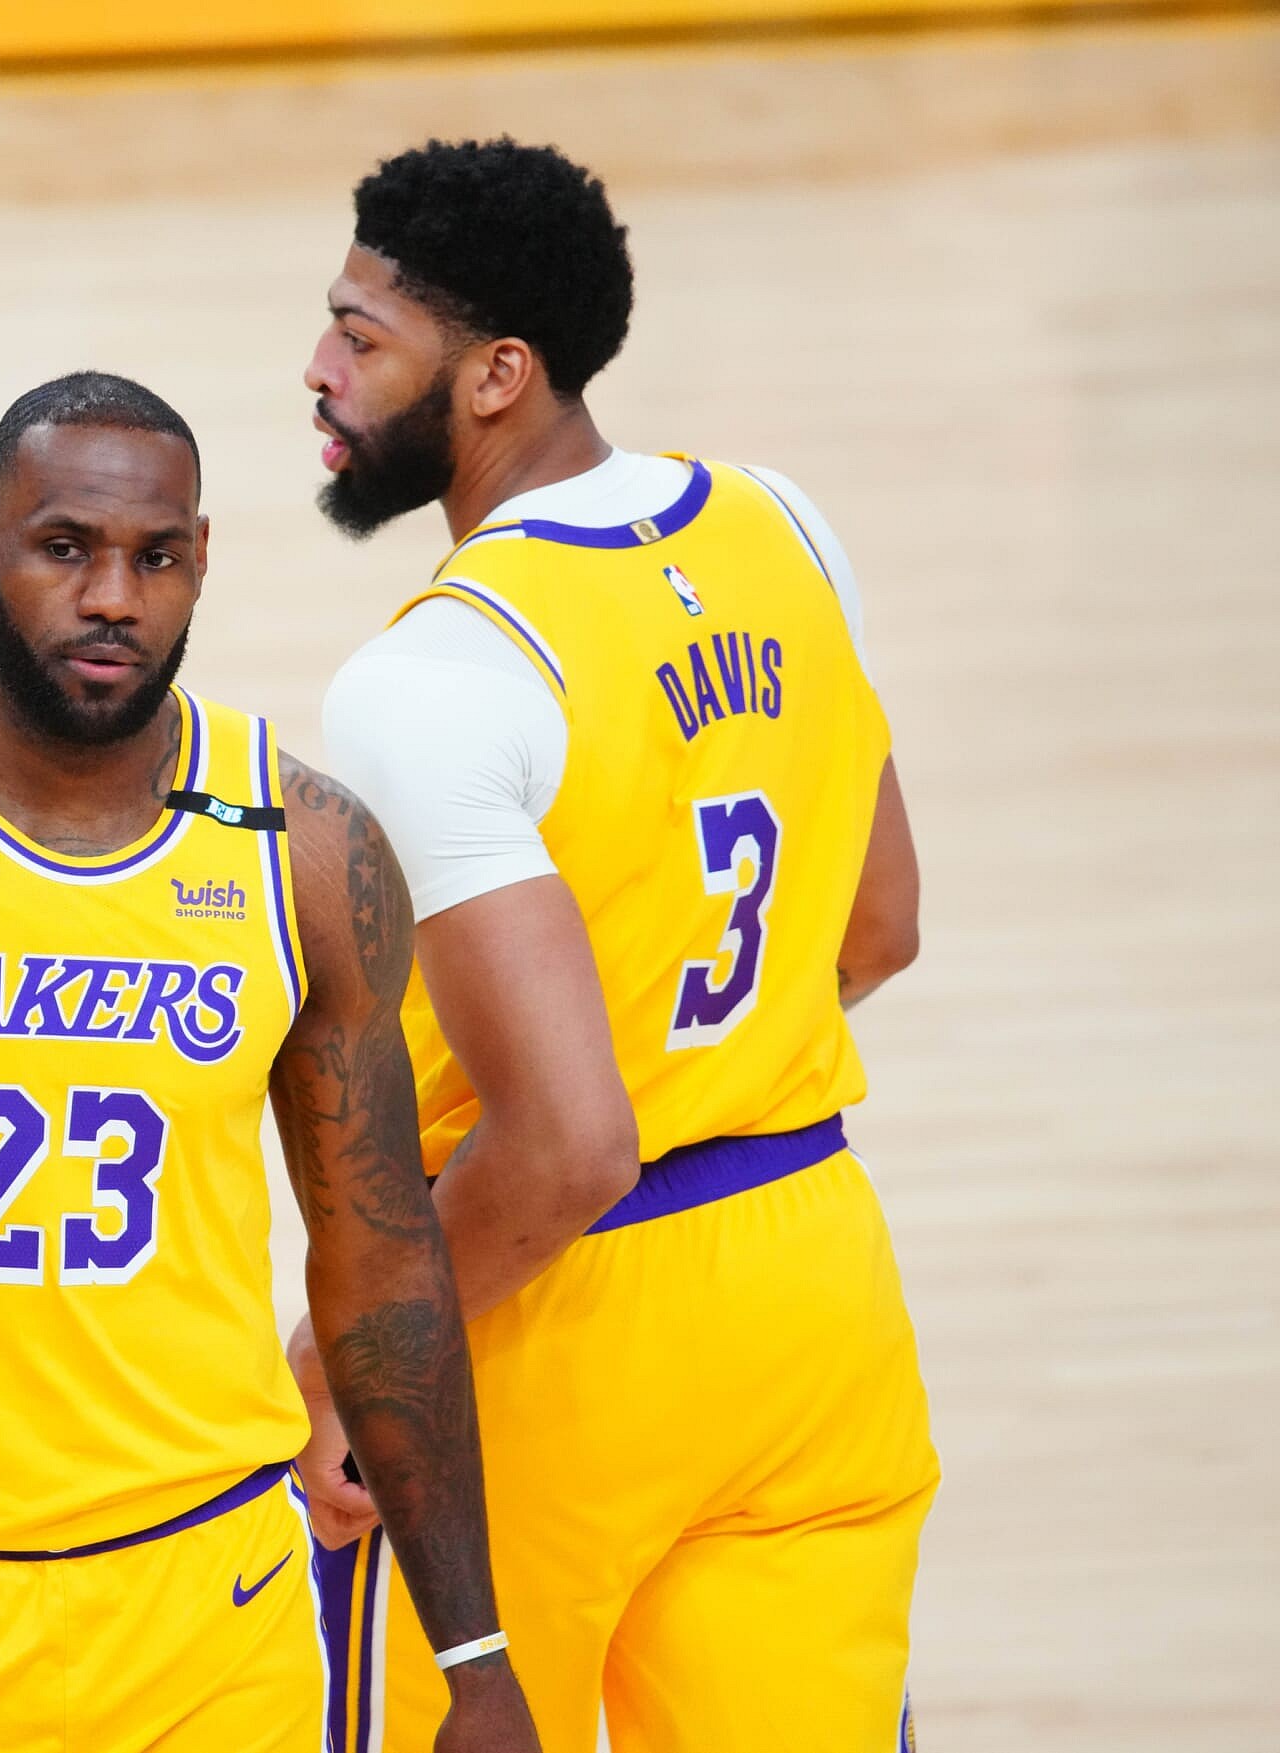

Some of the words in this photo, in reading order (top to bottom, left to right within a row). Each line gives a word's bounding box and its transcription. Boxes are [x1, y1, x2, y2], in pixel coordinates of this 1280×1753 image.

[655, 631, 782, 742] DAVIS
[171, 878, 245, 908] wish
[176, 908, 246, 920] SHOPPING
[665, 788, 783, 1053] 3
